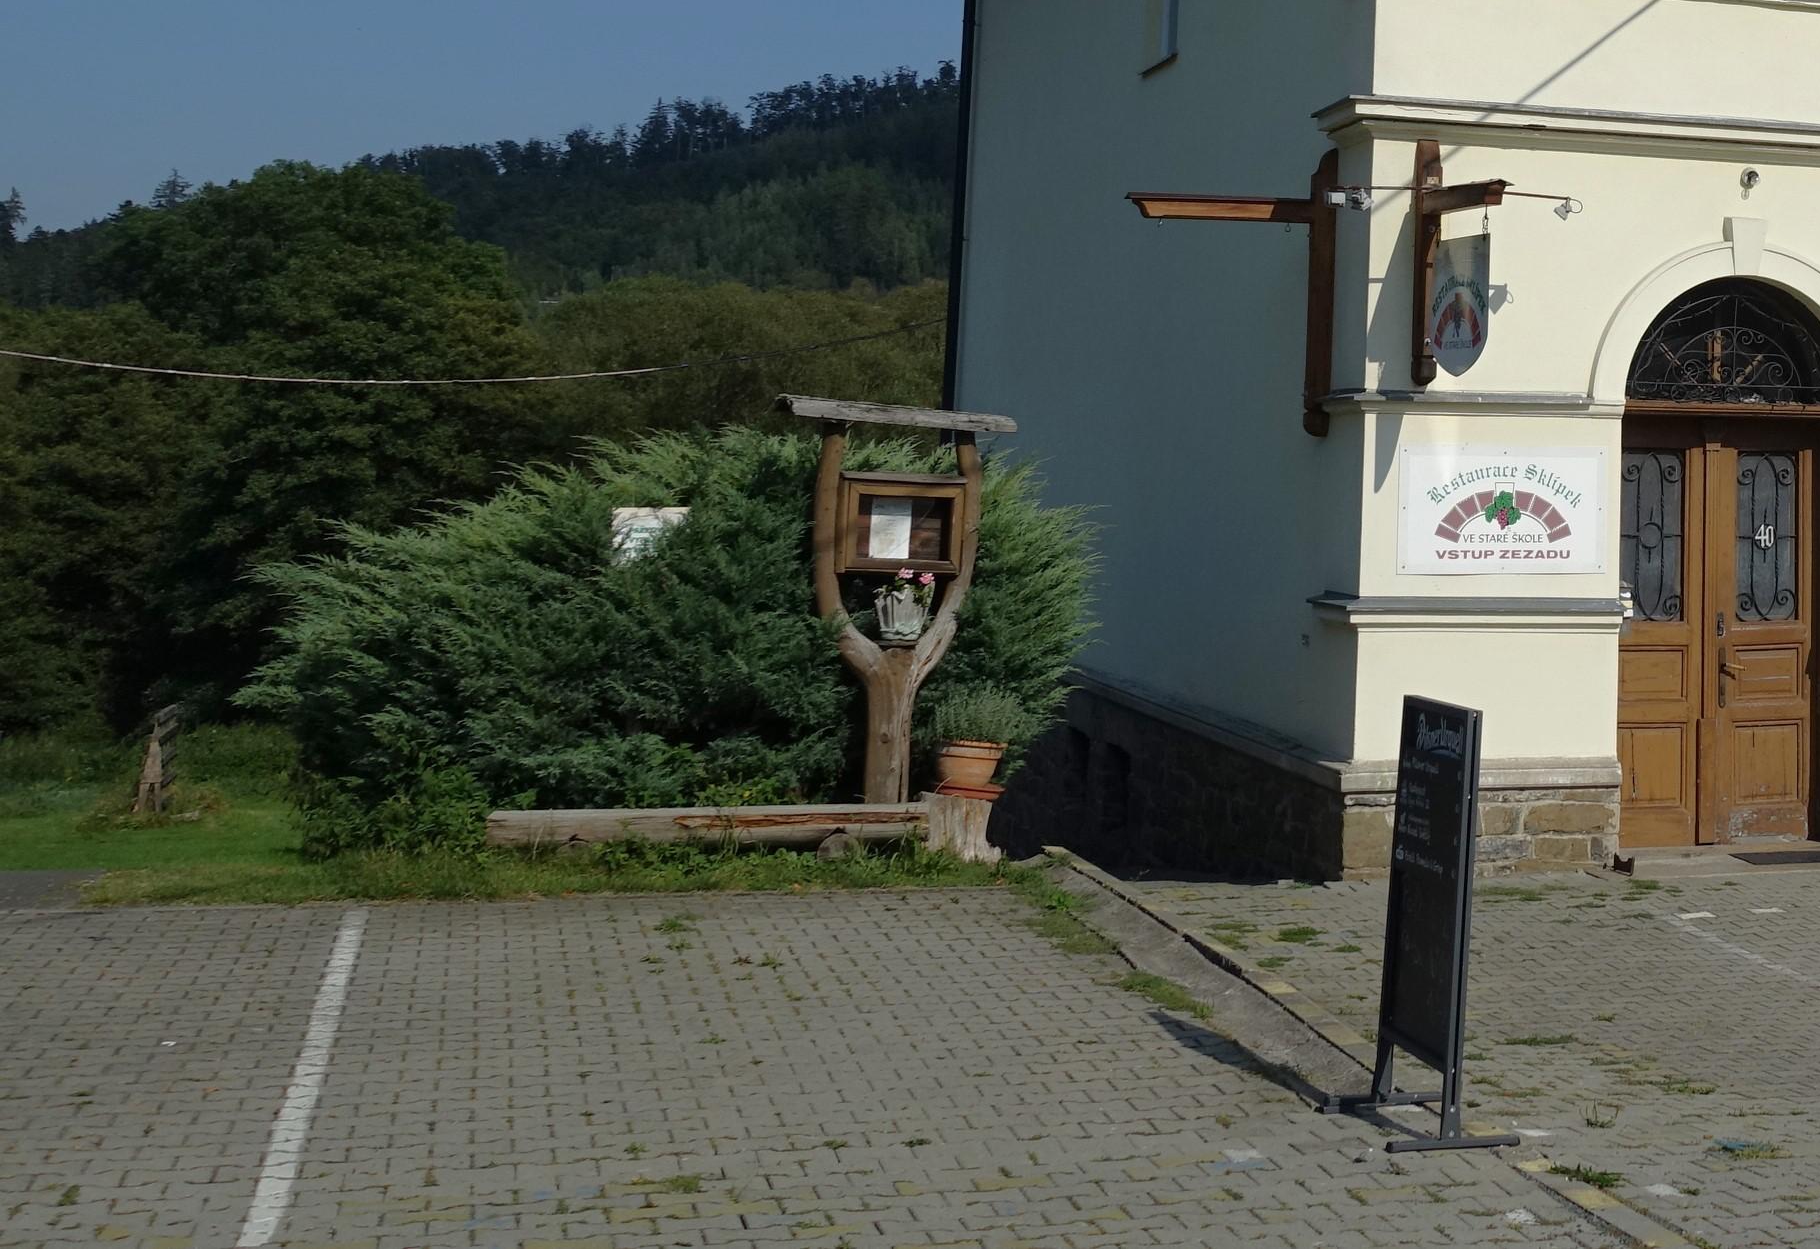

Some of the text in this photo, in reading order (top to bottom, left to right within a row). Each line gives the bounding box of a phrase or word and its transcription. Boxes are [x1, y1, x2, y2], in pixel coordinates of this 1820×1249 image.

[1427, 463, 1583, 509] Restaurace Sklípek
[1463, 531, 1543, 543] VE STARÉ ŠKOLE
[1754, 523, 1774, 548] 40
[1436, 549, 1571, 560] VSTUP ZEZADU
